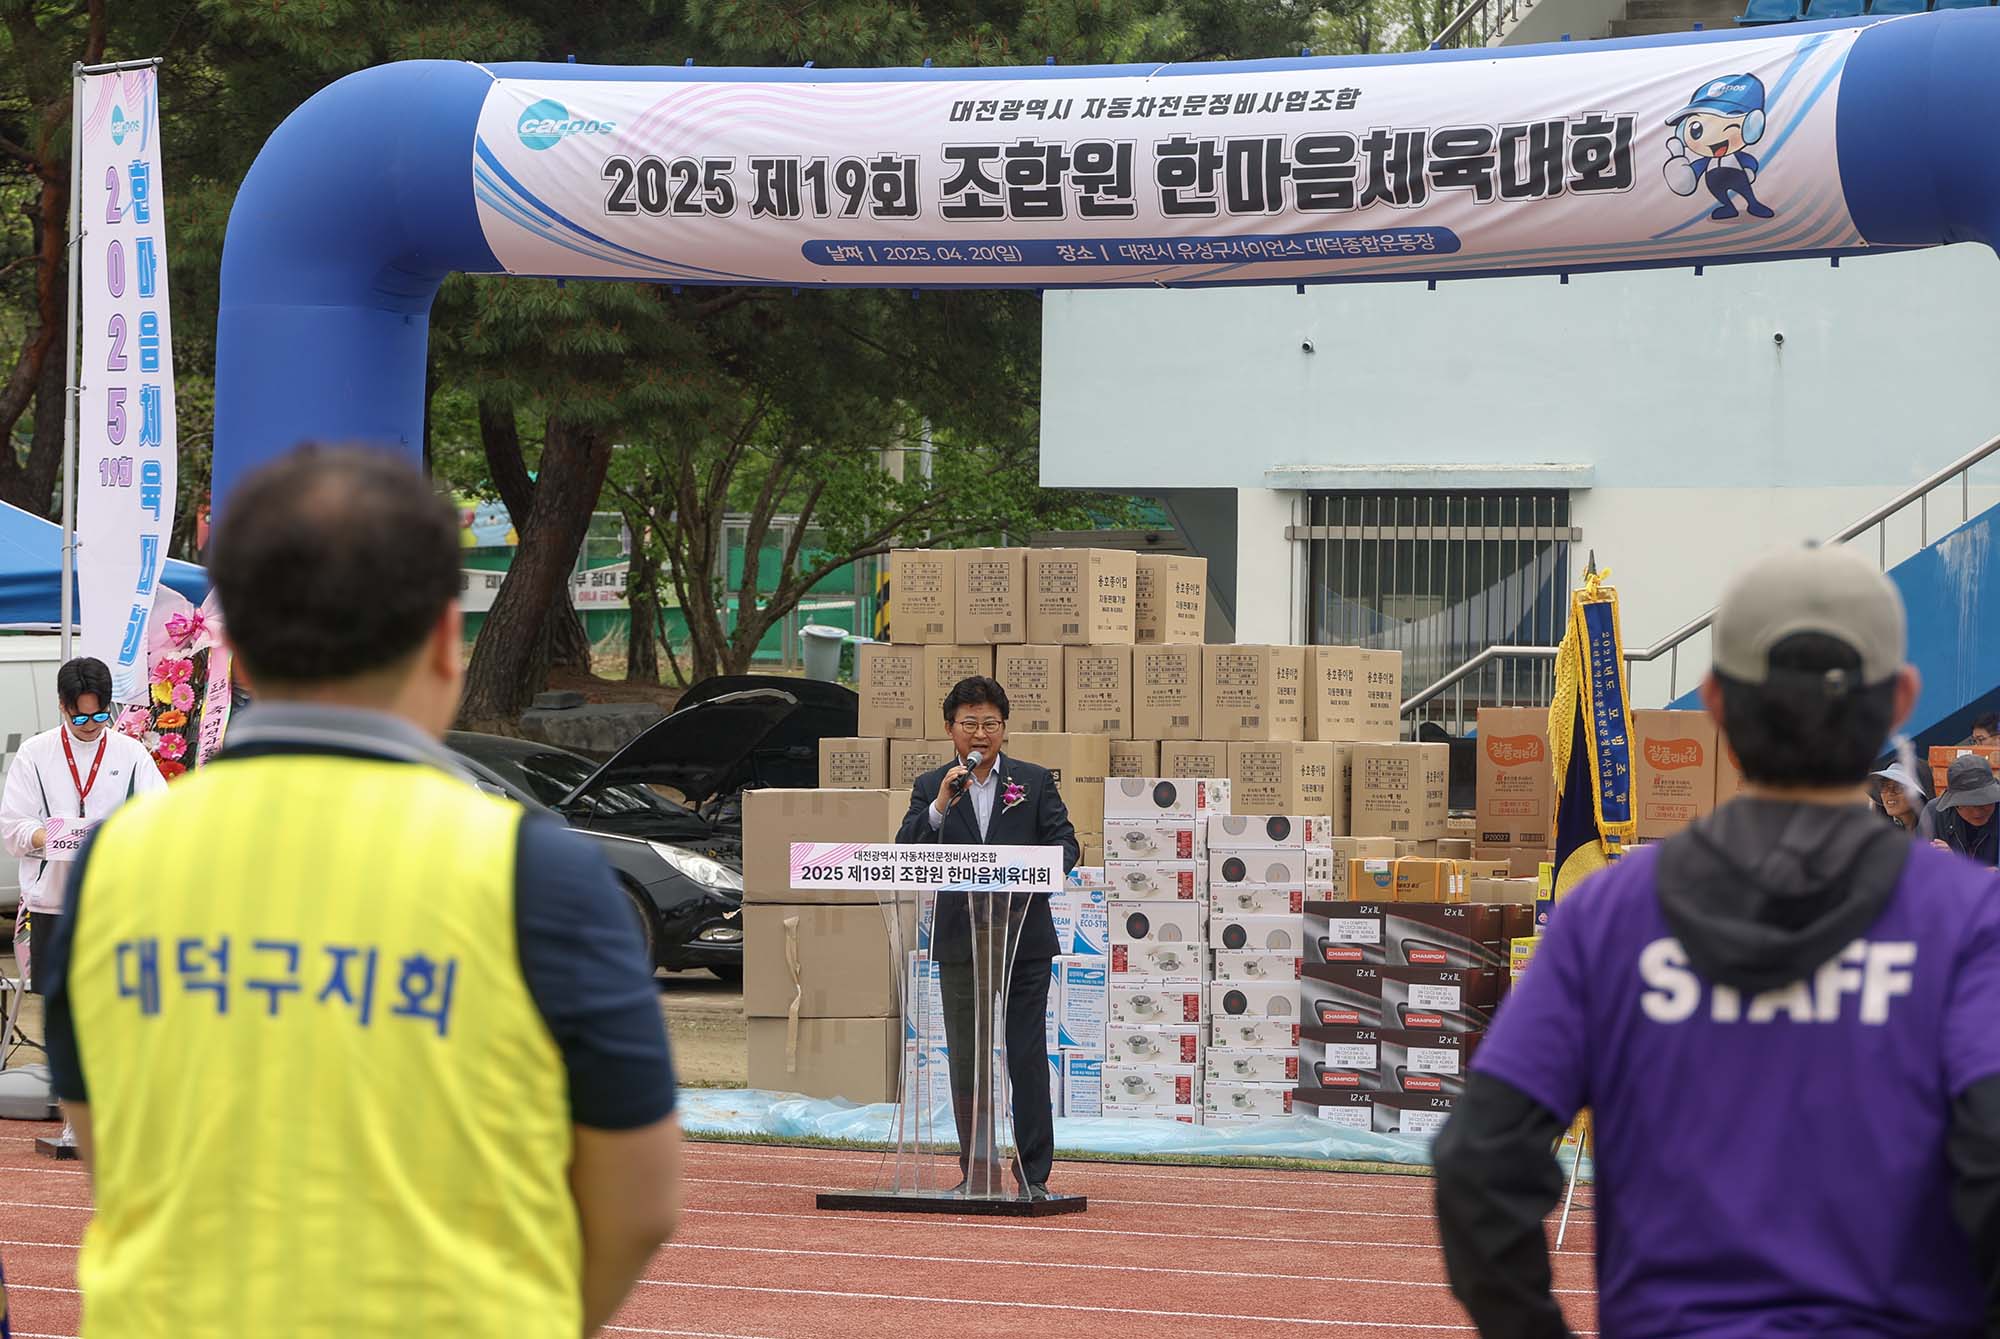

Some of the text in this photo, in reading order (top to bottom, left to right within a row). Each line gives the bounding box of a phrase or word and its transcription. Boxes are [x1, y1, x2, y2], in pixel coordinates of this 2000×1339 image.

[948, 87, 1362, 122] 대전광역시 자동차전문정비사업조합
[602, 111, 1639, 222] 2025 제19회 조합원 한마음체육대회
[825, 245, 865, 262] 날짜
[1056, 244, 1097, 262] 장소
[105, 166, 128, 446] 2025
[99, 455, 134, 488] 19회
[1489, 741, 1539, 761] 잘풀리는집
[1647, 744, 1697, 764] 잘풀리는집
[52, 840, 80, 850] 2025
[853, 851, 997, 863] 대전광역시 자동차전문정비사업조합
[801, 865, 1051, 886] 2025 제19회 조합원 한마음체육대회
[114, 935, 458, 1038] 대덕구지회
